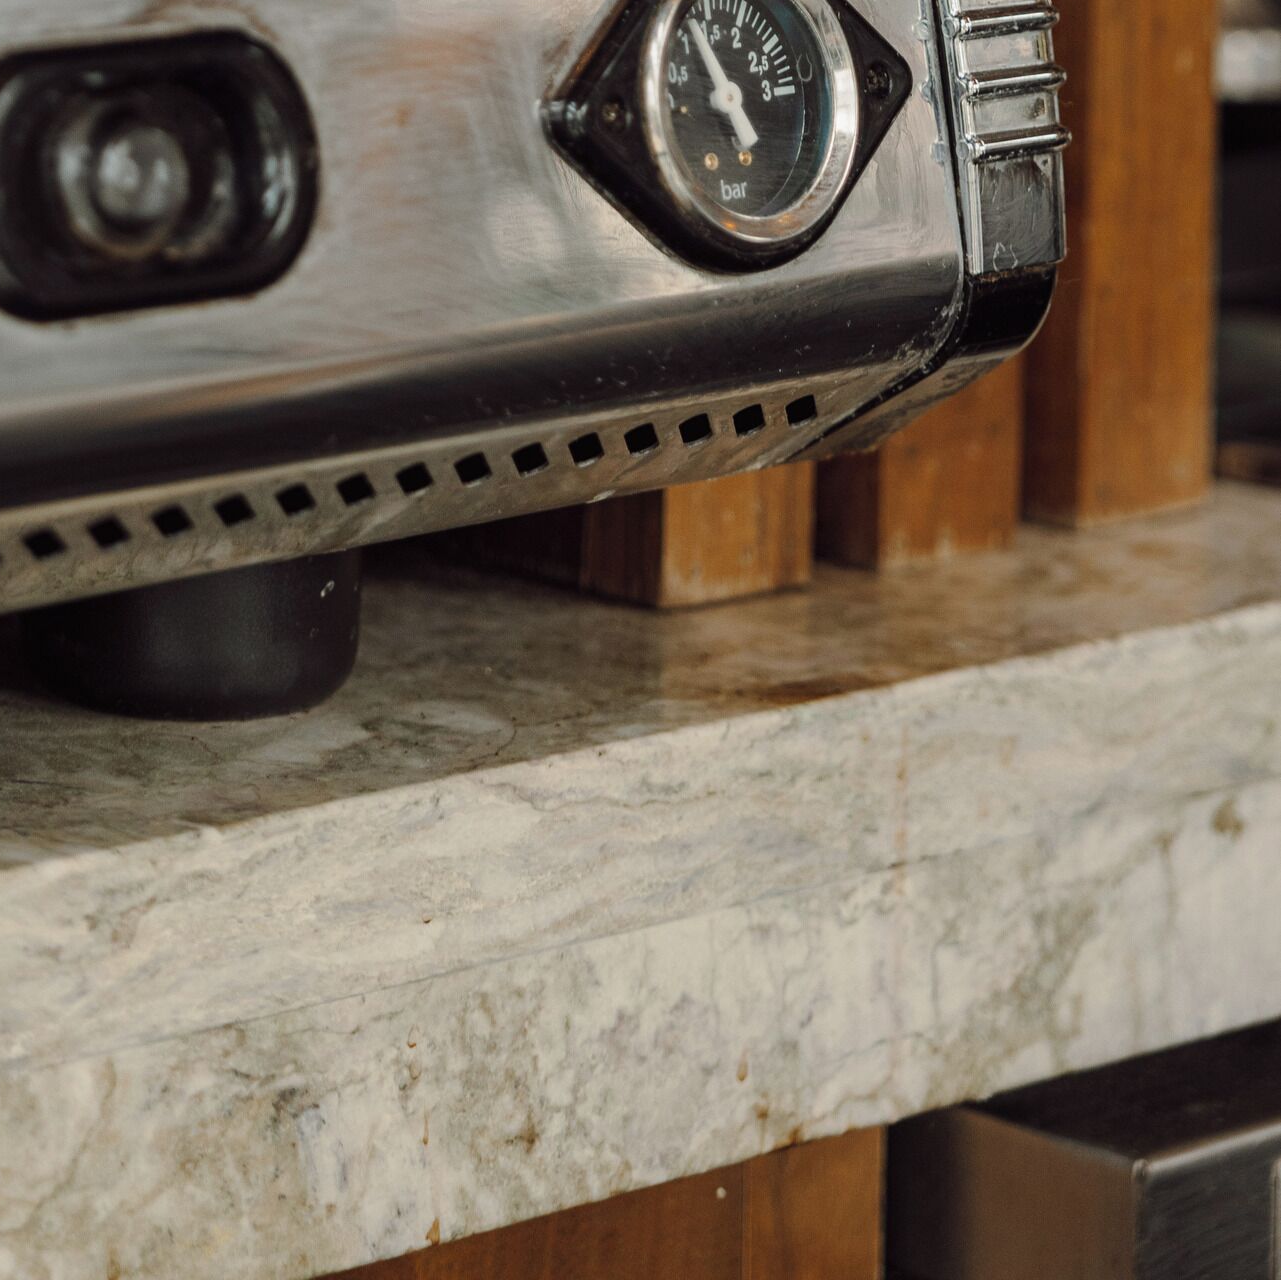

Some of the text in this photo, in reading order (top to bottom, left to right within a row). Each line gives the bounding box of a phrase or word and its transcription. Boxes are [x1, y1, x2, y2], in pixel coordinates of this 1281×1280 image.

[681, 33, 690, 55] 1
[731, 27, 742, 49] 2
[668, 62, 689, 86] 0,5
[748, 51, 769, 76] 2,5
[761, 80, 772, 102] 3
[720, 179, 748, 202] bar
